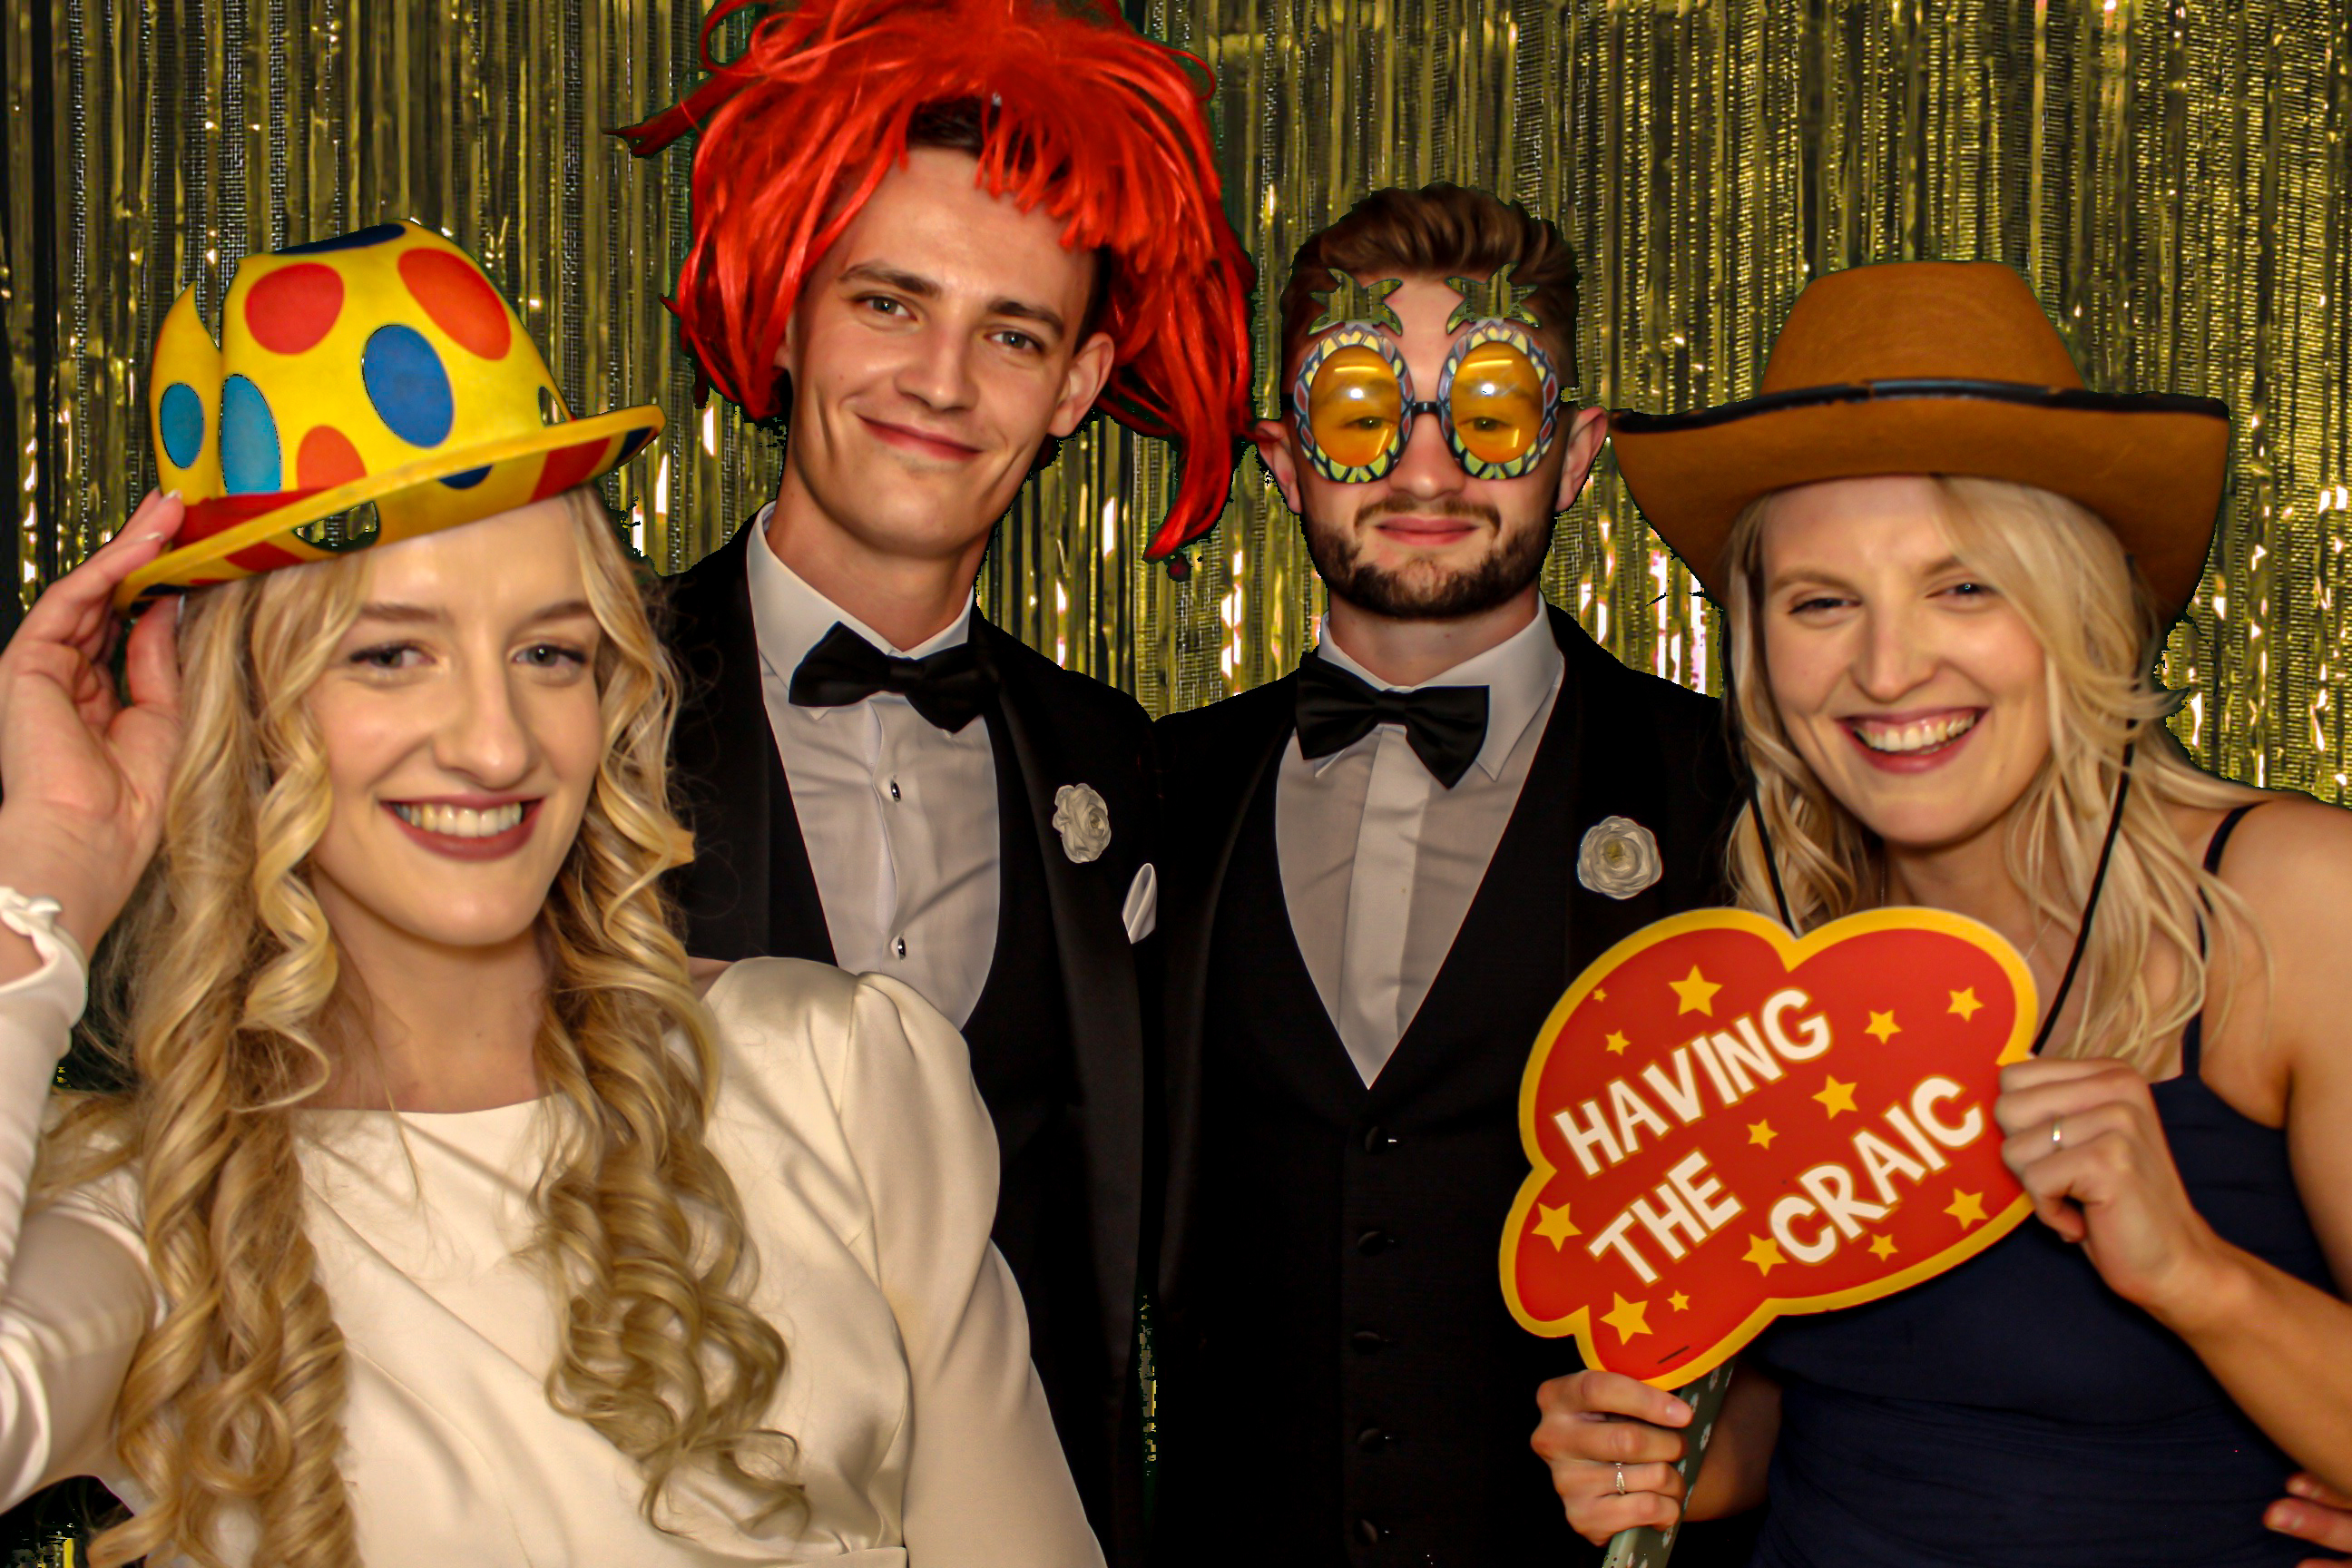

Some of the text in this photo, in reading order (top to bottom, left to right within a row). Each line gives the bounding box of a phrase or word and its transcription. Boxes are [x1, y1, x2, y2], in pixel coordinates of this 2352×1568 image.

[1553, 989, 1831, 1176] HAVING
[1769, 1076, 1984, 1263] CRAIC
[1588, 1151, 1742, 1284] THE
